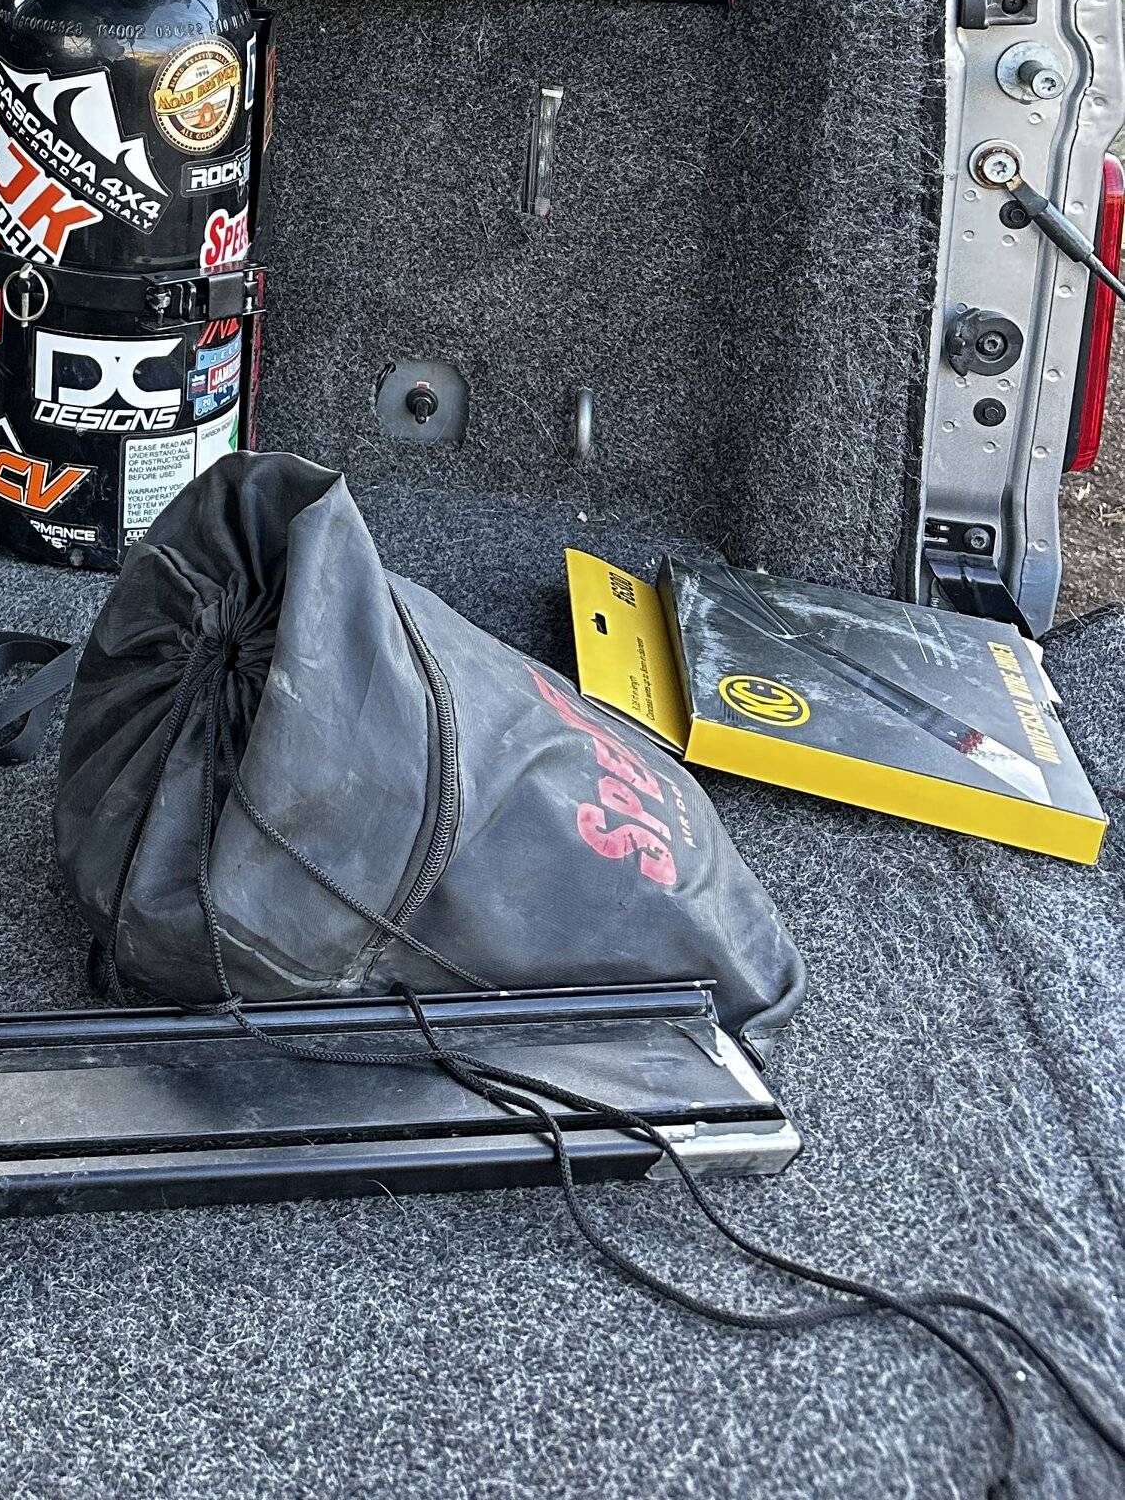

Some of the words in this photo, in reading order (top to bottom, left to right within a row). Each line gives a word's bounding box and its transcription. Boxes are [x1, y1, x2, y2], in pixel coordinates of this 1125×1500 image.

[72, 175, 153, 230] ANOMALY
[100, 177, 162, 221] 4X4
[34, 401, 179, 431] DESIGNS
[128, 444, 157, 452] PLEASE
[160, 441, 179, 449] READ
[180, 438, 194, 447] AND
[128, 449, 177, 460] UNDERSTAND
[128, 459, 139, 467] OF
[140, 453, 191, 466] INSTRUCTIONS
[145, 462, 183, 473] WARNINGS
[128, 472, 157, 481] BEFORE
[127, 486, 168, 495] WARRANTY
[127, 495, 143, 503] YOU
[127, 501, 157, 510] SYSTEM
